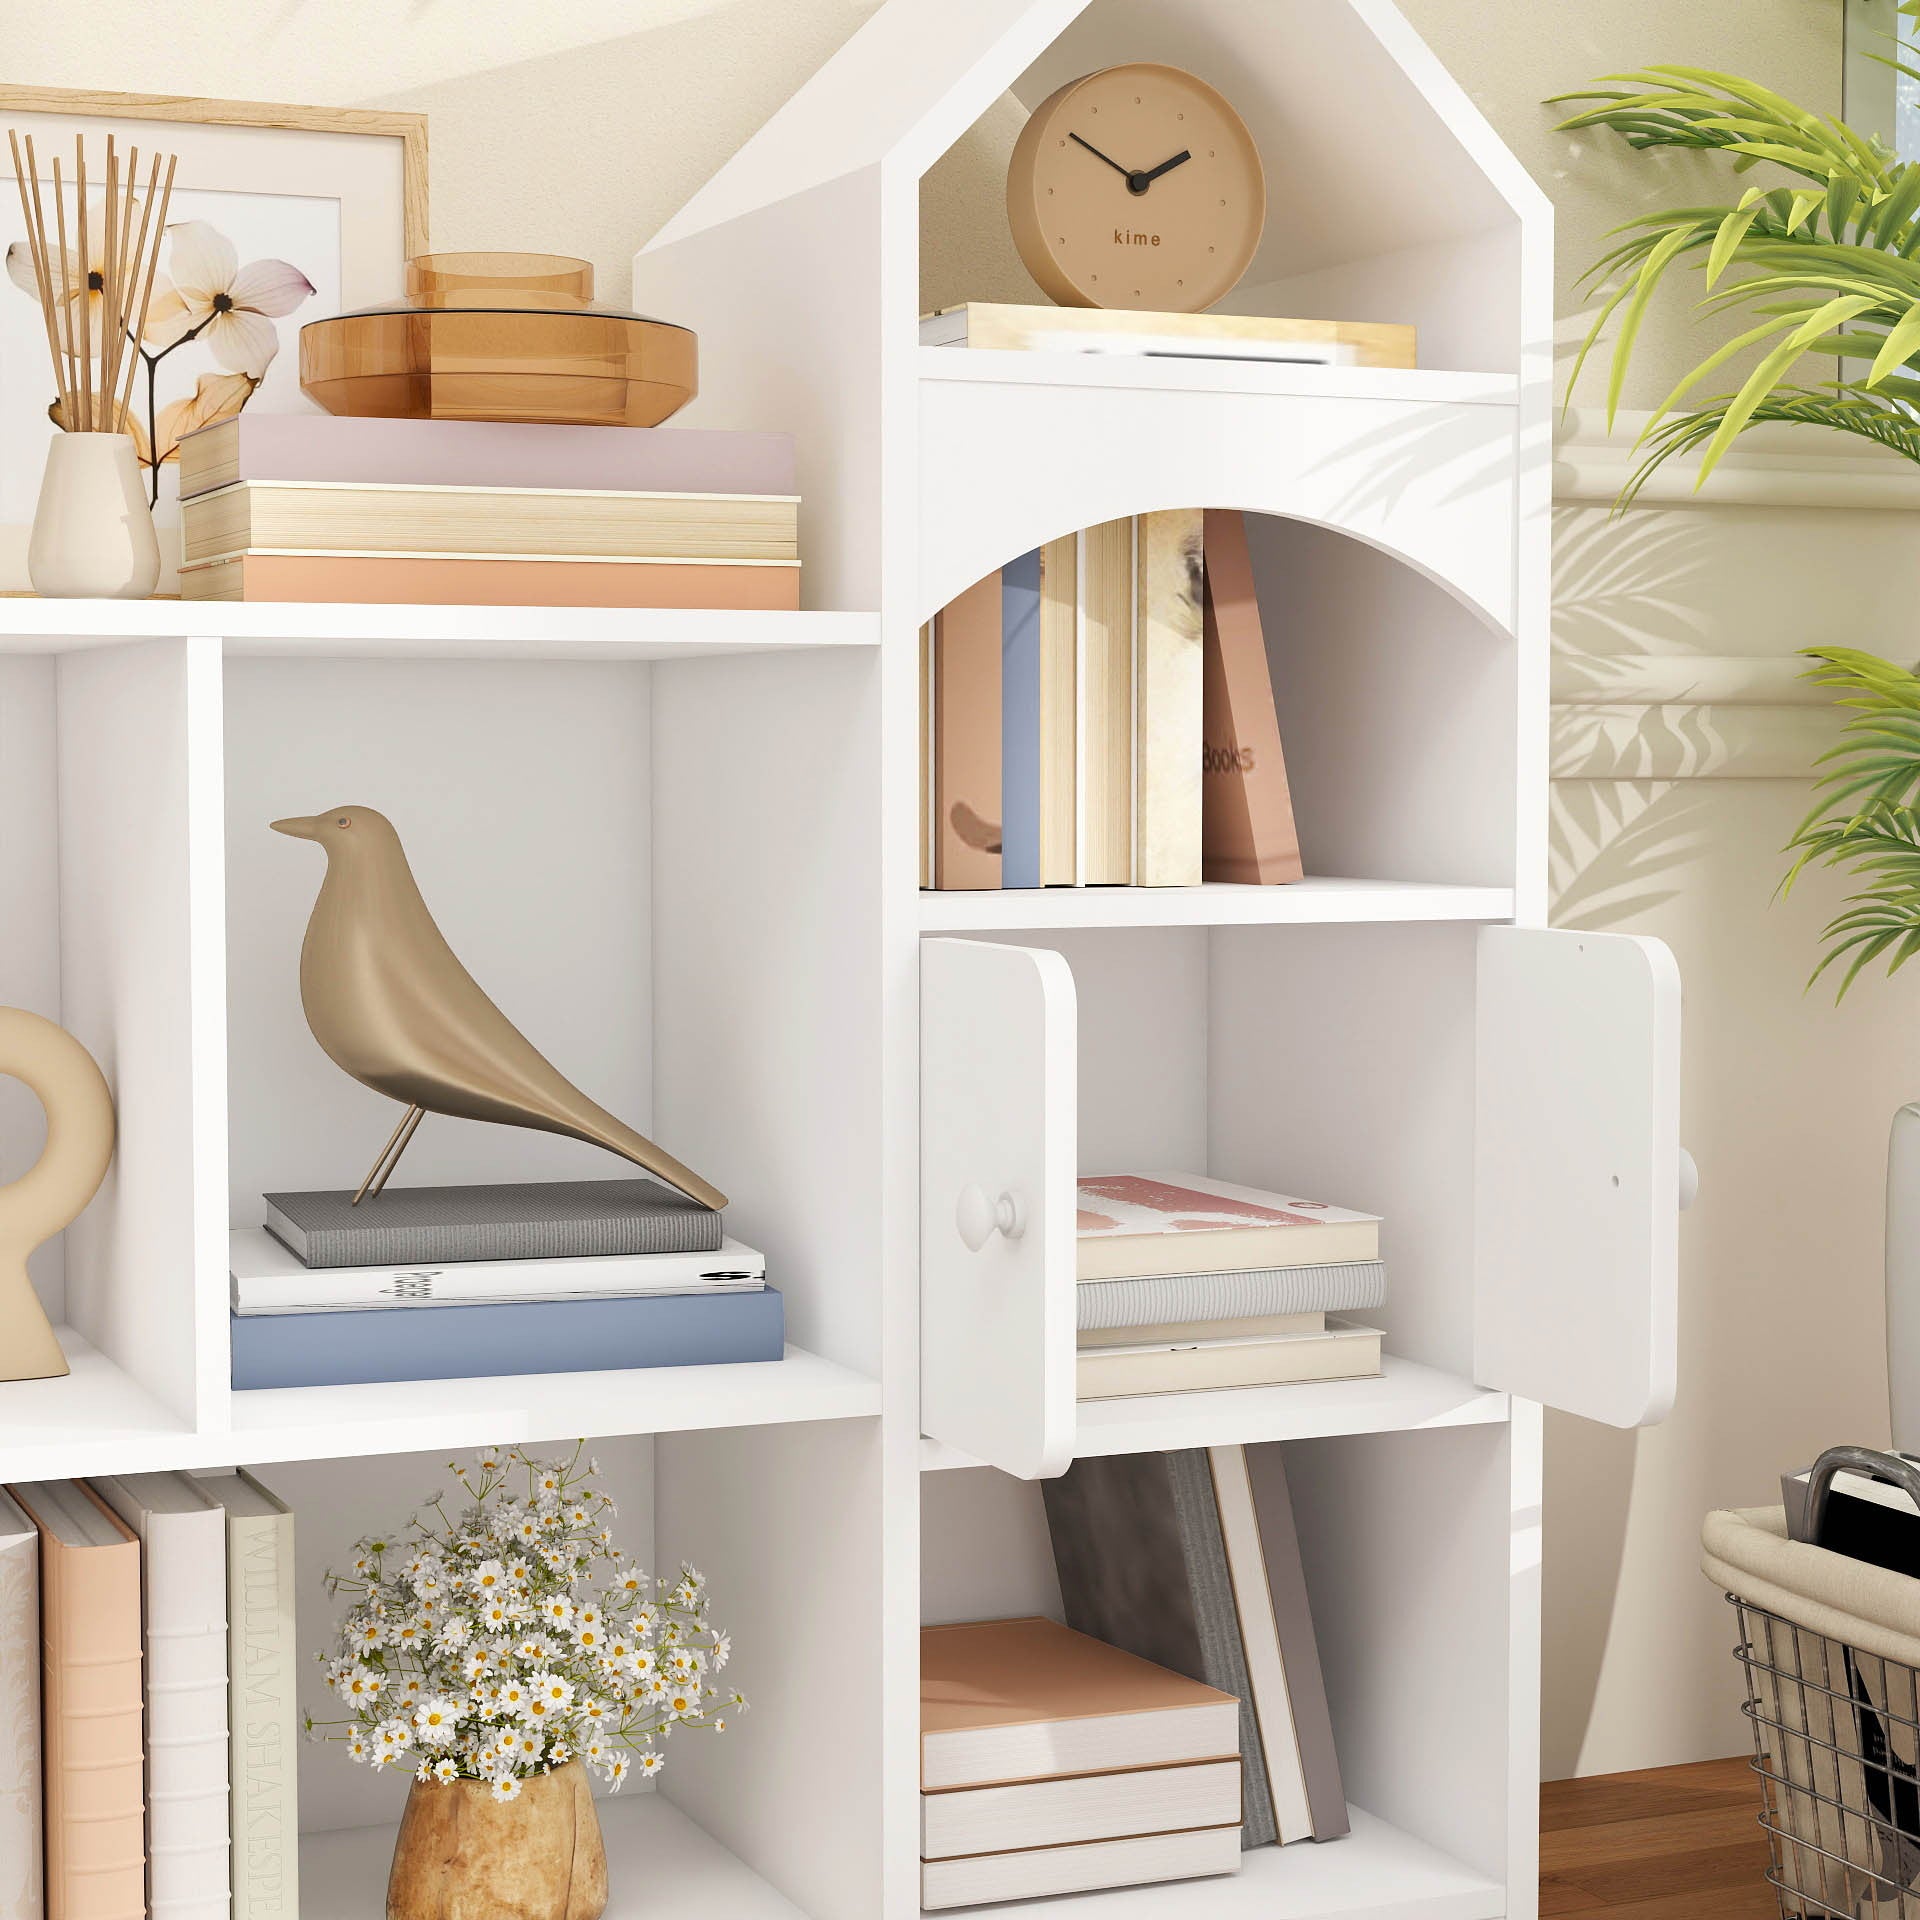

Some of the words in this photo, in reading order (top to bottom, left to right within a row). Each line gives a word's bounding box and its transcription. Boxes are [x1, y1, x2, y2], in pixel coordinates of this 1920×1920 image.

[1114, 228, 1161, 247] kime
[244, 1521, 281, 1711] WILLIAM
[245, 1721, 283, 1920] SHAKESPE
